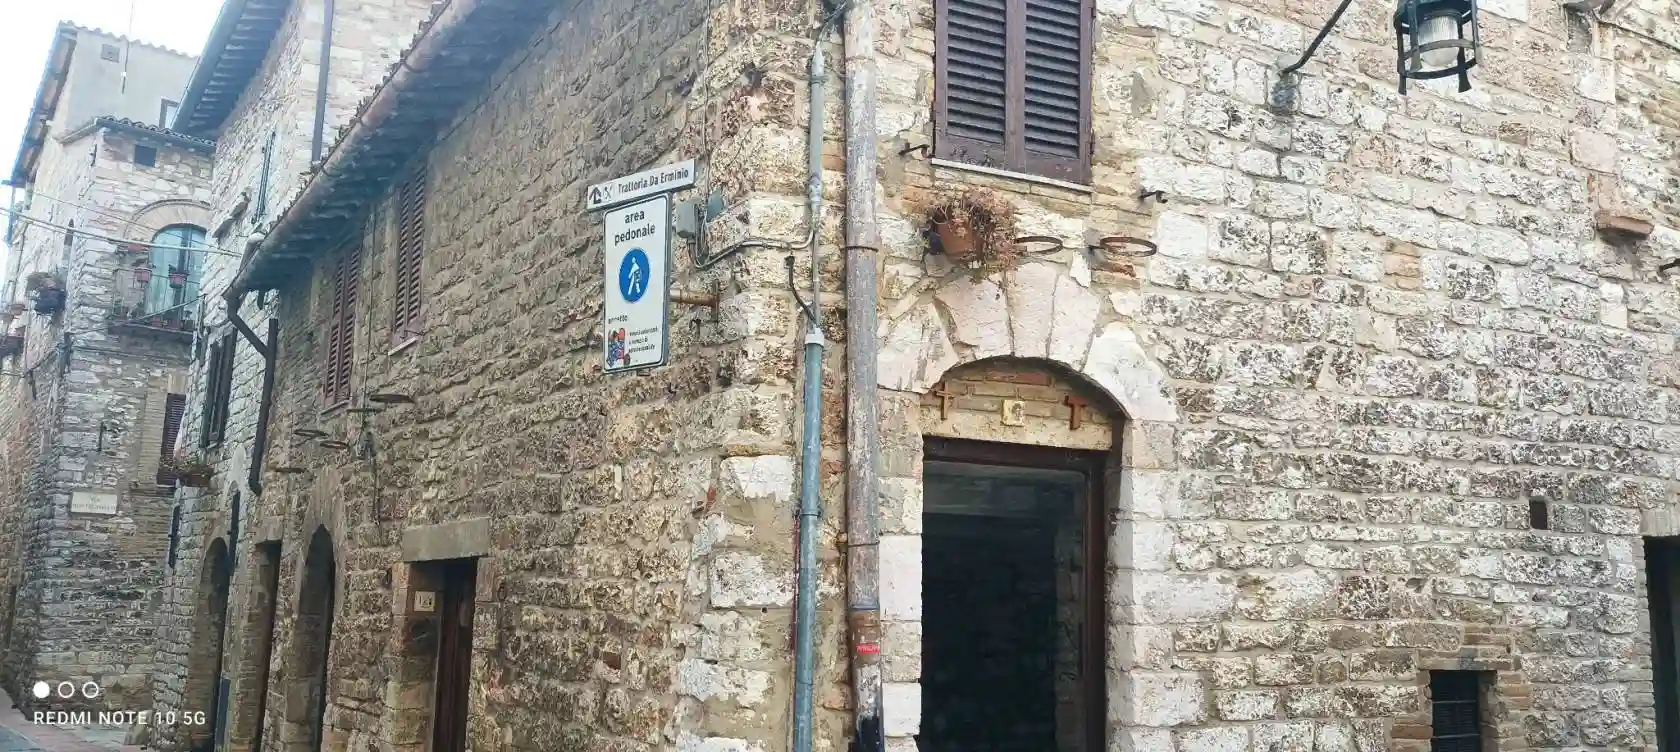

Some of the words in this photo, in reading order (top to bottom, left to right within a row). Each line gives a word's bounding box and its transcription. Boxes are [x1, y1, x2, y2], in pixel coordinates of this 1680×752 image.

[618, 178, 648, 194] Trattoria
[649, 175, 659, 186] Da
[660, 168, 689, 184] Erminio
[624, 210, 645, 224] area
[614, 223, 656, 246] pedonale
